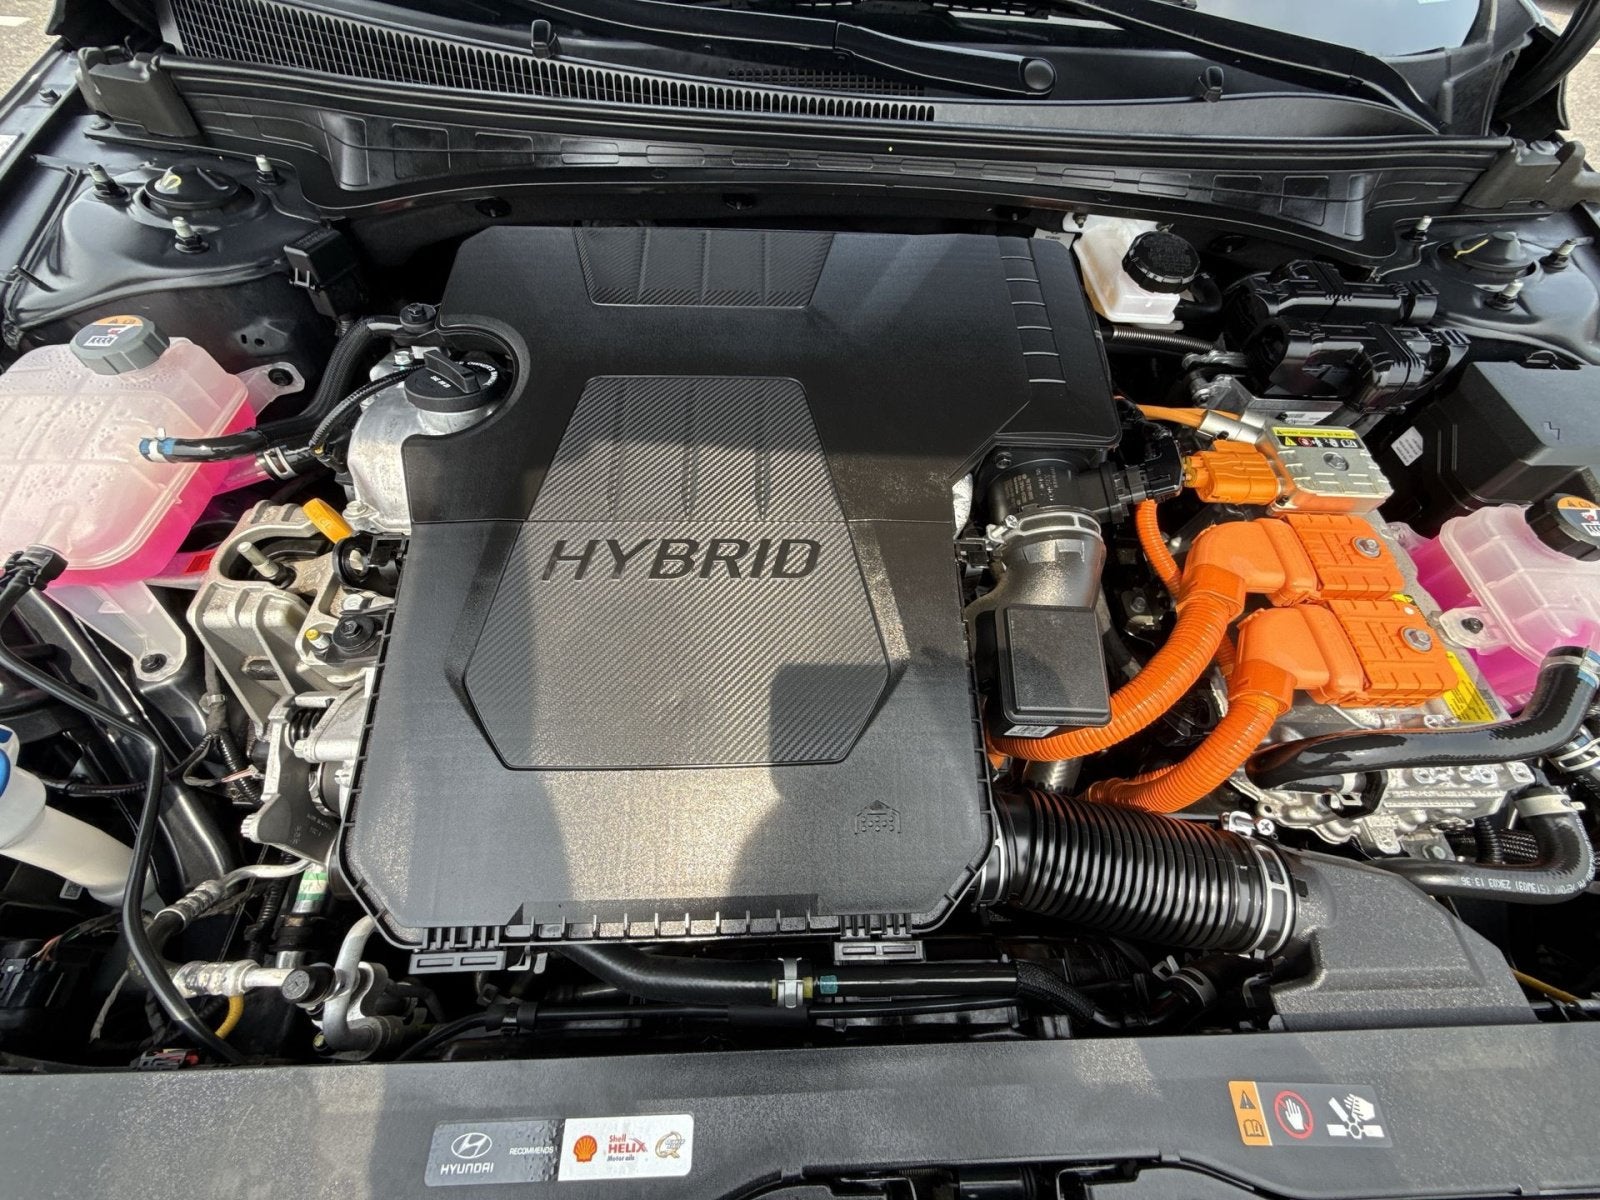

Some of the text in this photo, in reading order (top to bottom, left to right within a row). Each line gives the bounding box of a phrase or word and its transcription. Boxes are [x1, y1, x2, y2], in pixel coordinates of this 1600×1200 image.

[542, 538, 823, 581] HYBRID
[609, 1133, 627, 1143] Shell
[509, 1146, 554, 1155] RECOMMENDS
[608, 1139, 648, 1154] HELIX
[440, 1164, 494, 1176] HYUNDAI
